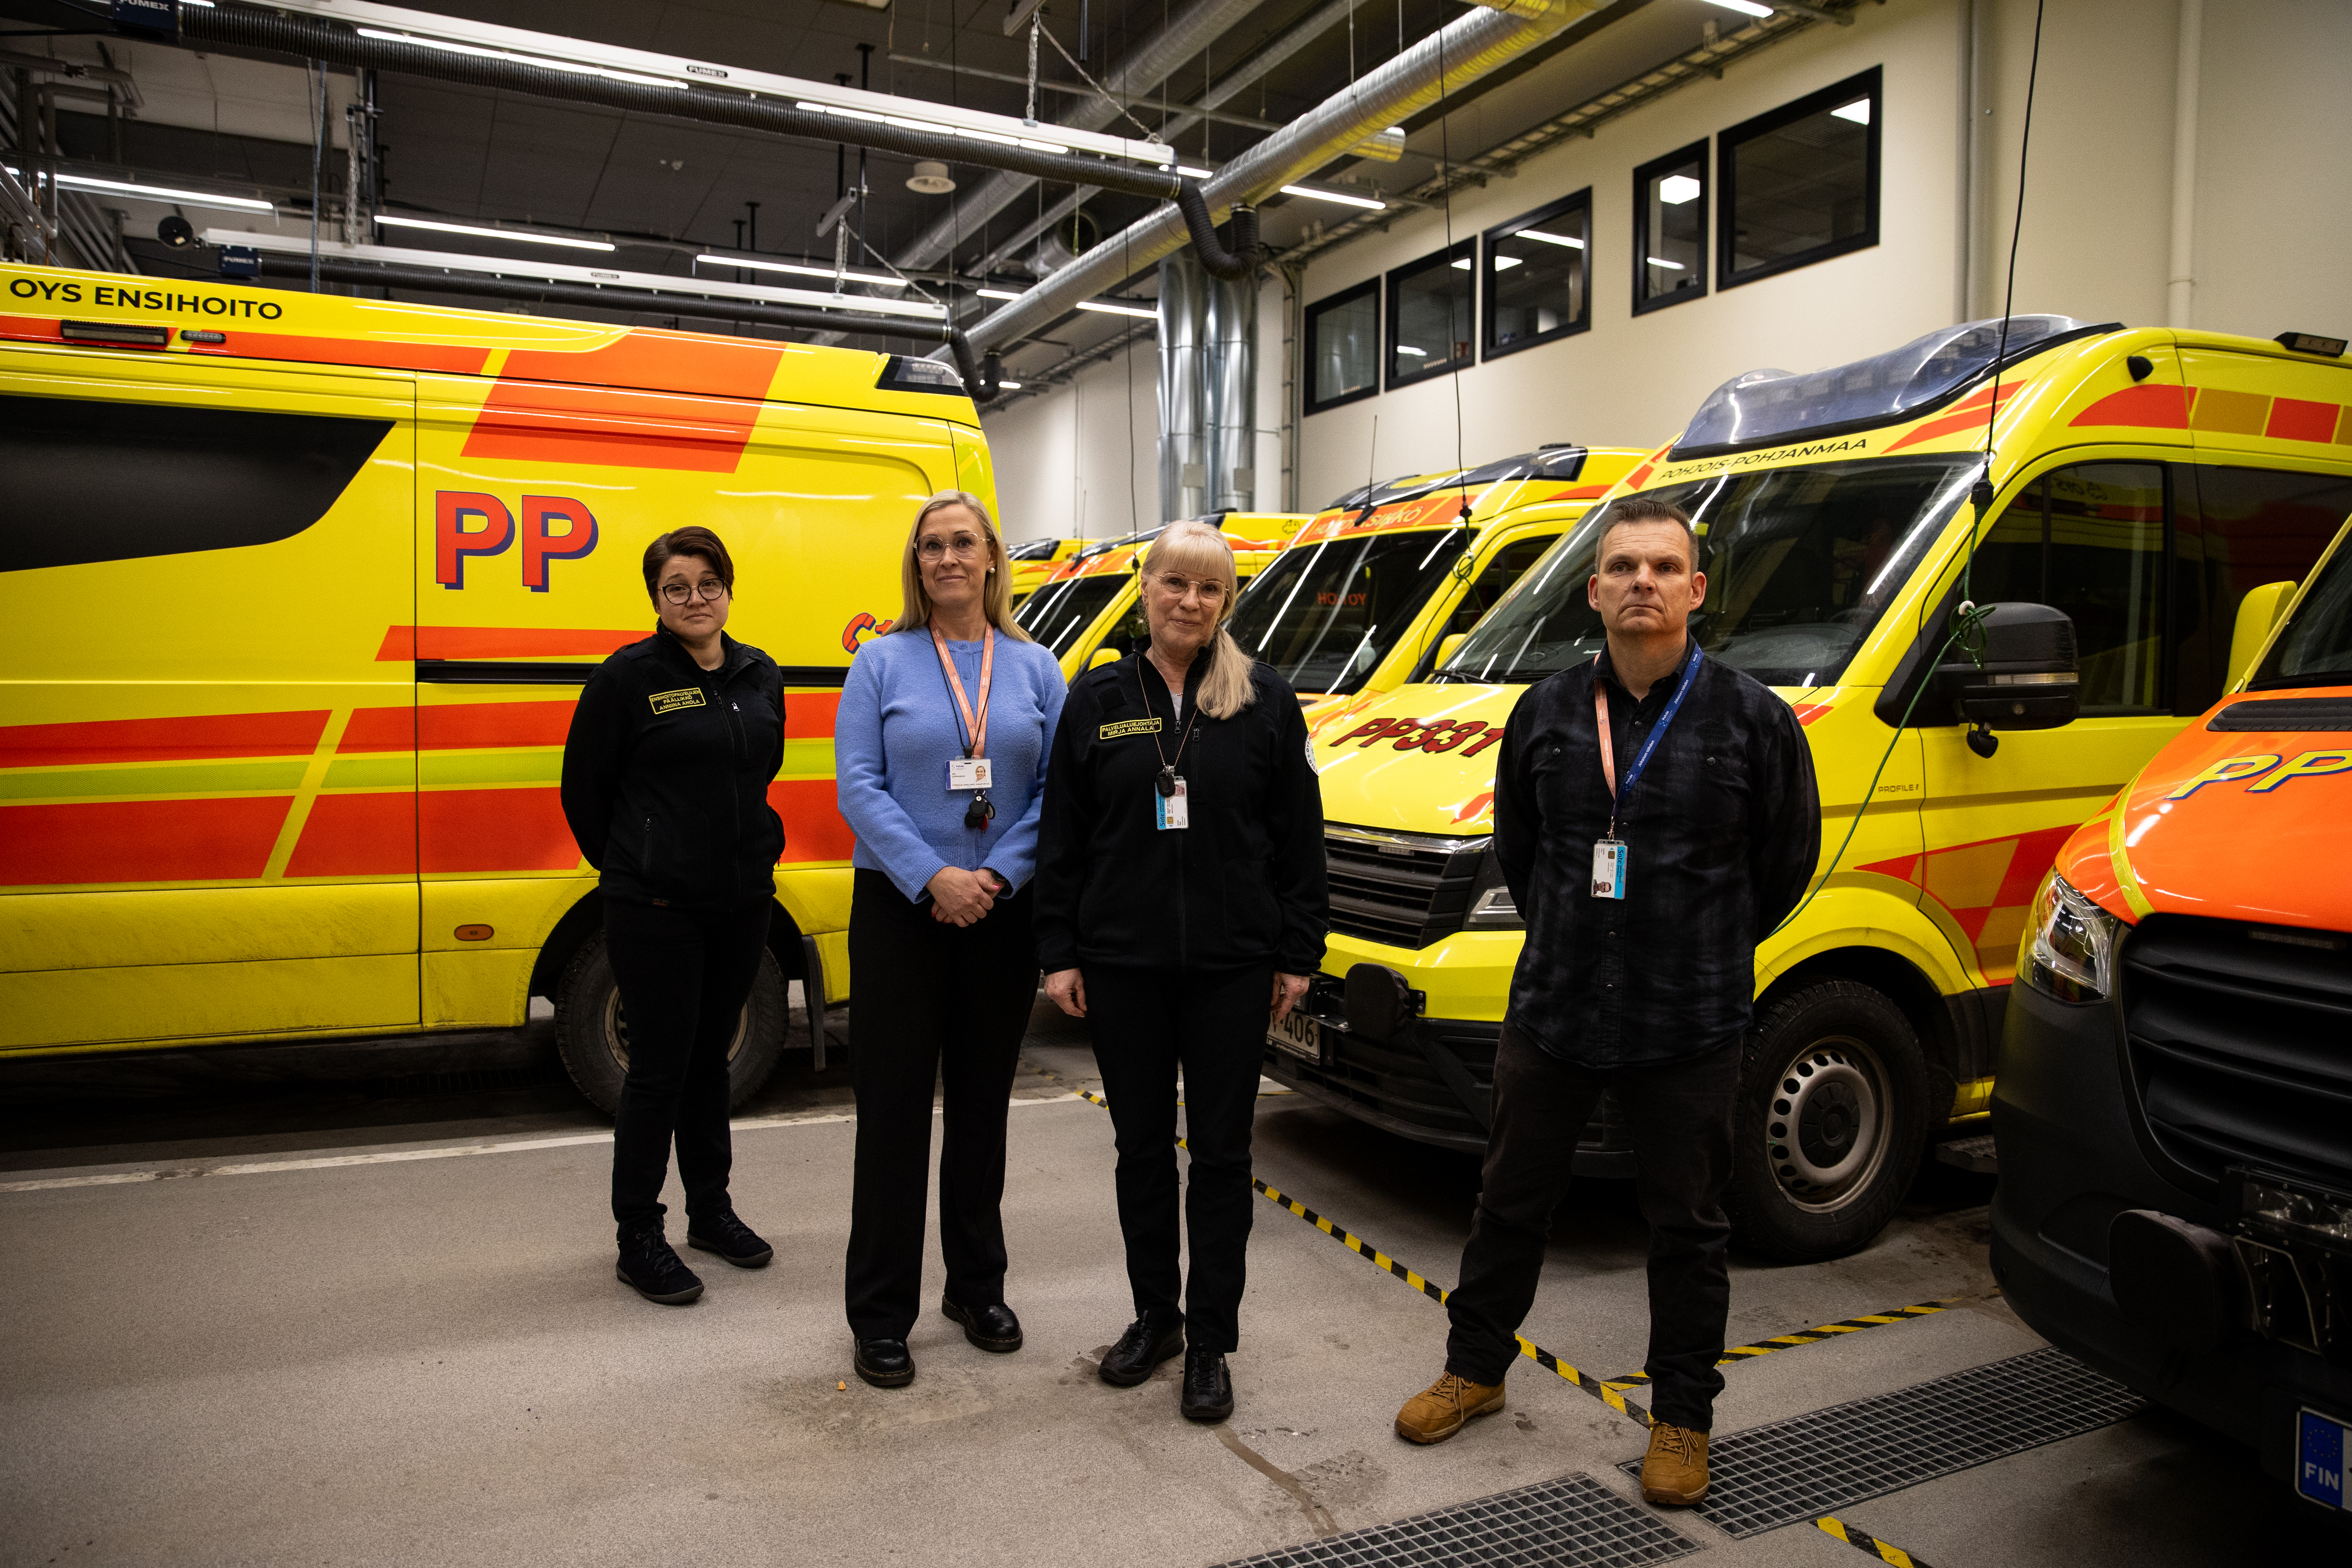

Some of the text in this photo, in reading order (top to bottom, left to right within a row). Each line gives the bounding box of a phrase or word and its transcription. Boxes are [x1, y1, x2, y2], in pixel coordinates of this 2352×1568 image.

[689, 66, 725, 77] FUMEX
[9, 279, 282, 320] OYS ENSIHOITO
[1658, 439, 1867, 481] POHJOIS-POHJANMAA
[435, 490, 599, 593] PP
[651, 690, 700, 702] ENSIHOITOPALVELUJEN
[660, 702, 681, 710] ANNIINA
[663, 695, 692, 704] PÄÄLLIKKÖ
[1674, 690, 1683, 704] Jokaisen
[1102, 720, 1160, 732] PALVELUALUEJOHTAJA
[1328, 718, 1505, 758] PP331
[1638, 740, 1655, 767] Jokaisen tähden
[2163, 750, 2352, 800] PP
[1878, 784, 1914, 793] PROFILE
[2305, 1461, 2339, 1491] FIN
